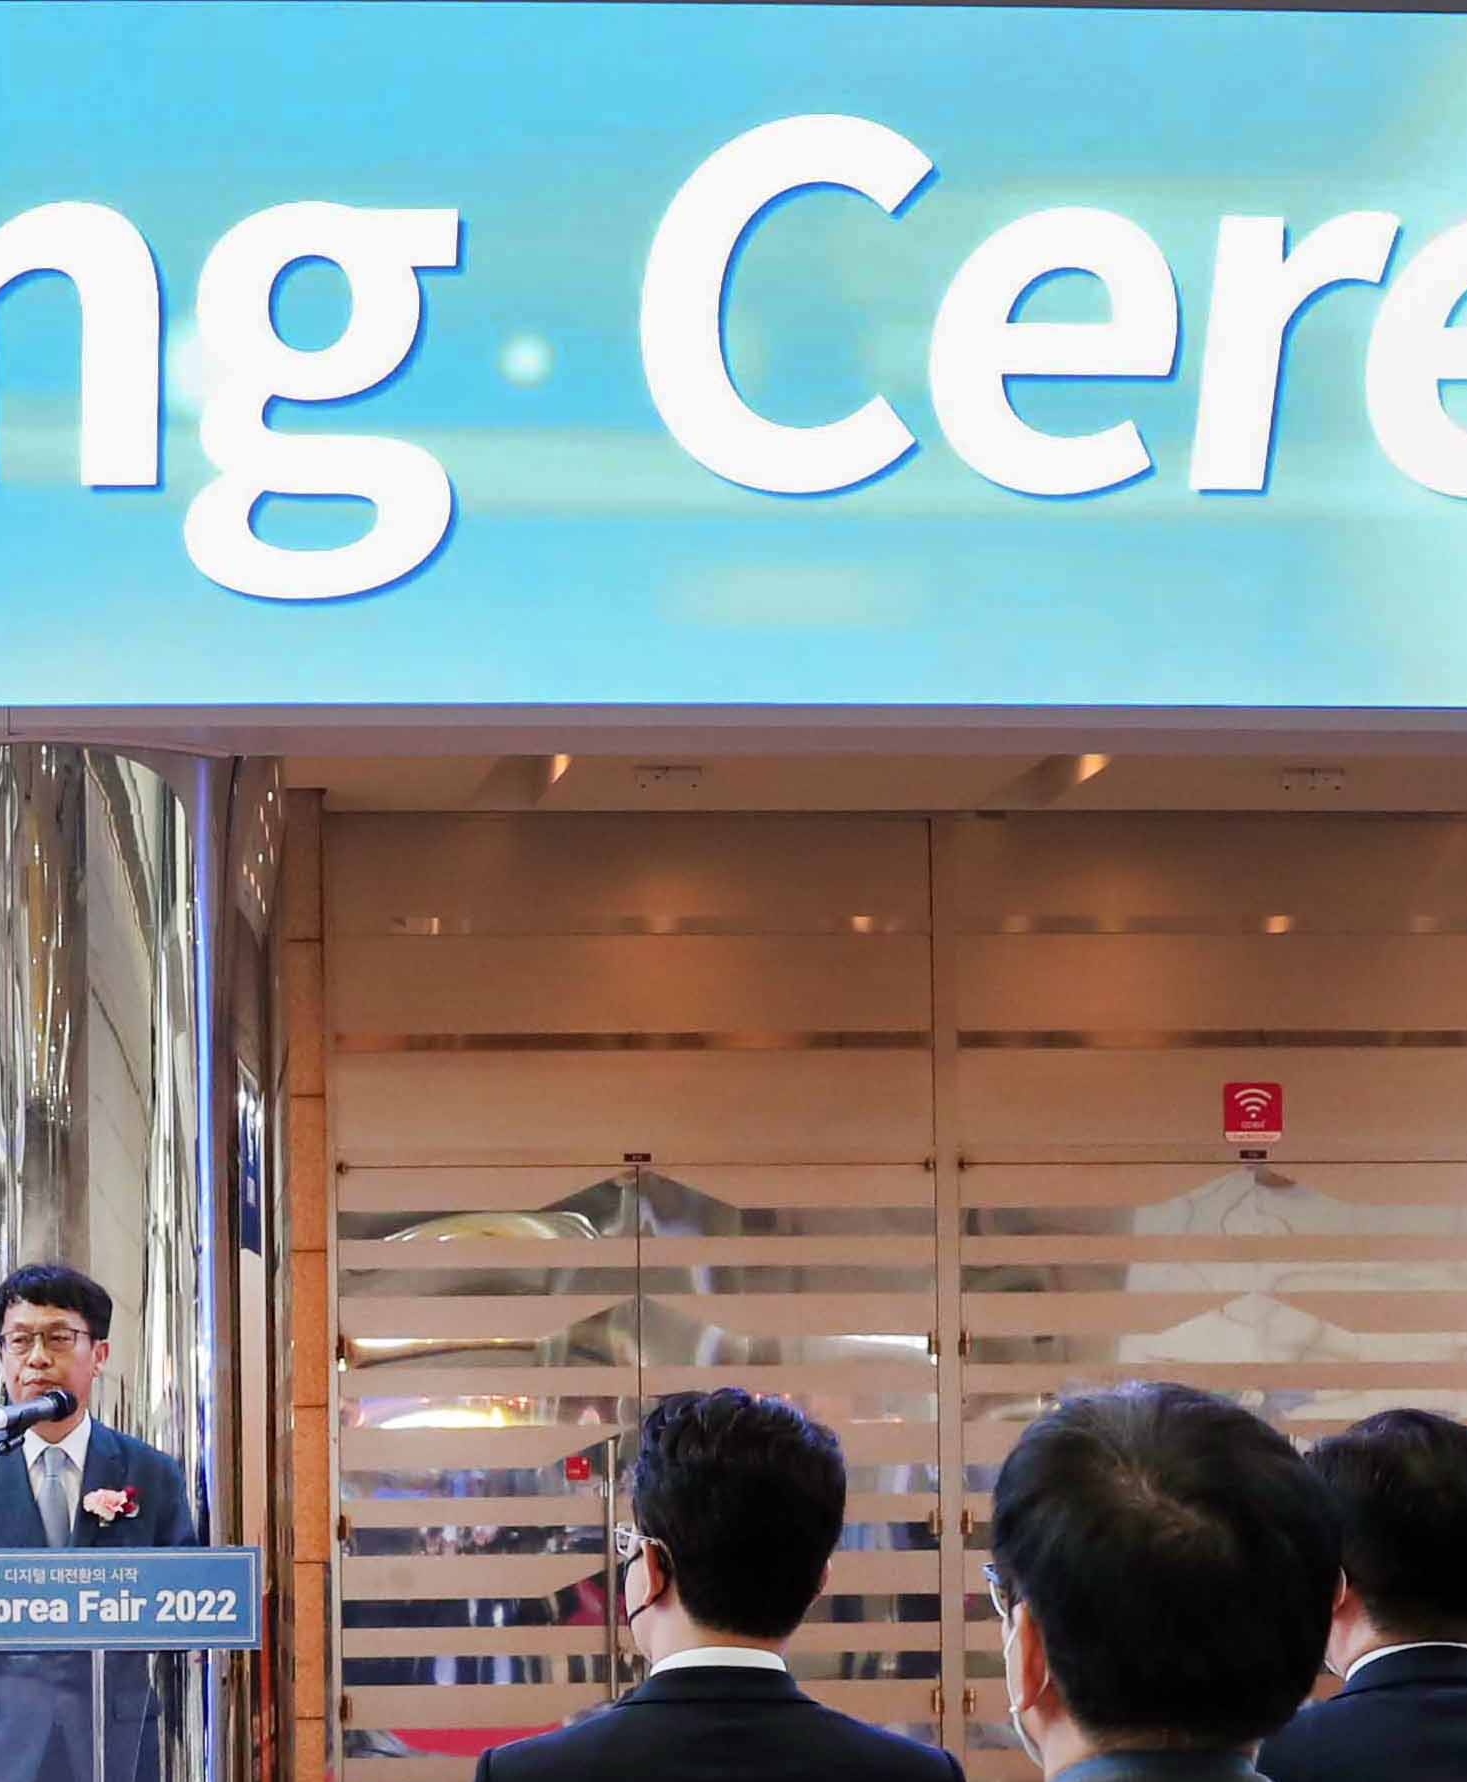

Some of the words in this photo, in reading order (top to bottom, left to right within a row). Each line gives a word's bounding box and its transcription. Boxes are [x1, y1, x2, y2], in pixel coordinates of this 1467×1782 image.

[4, 1568, 47, 1584] 디지털
[49, 1568, 107, 1584] 대전환의
[110, 1568, 139, 1584] 시작
[79, 1590, 147, 1622] Fair
[155, 1590, 238, 1621] 2022
